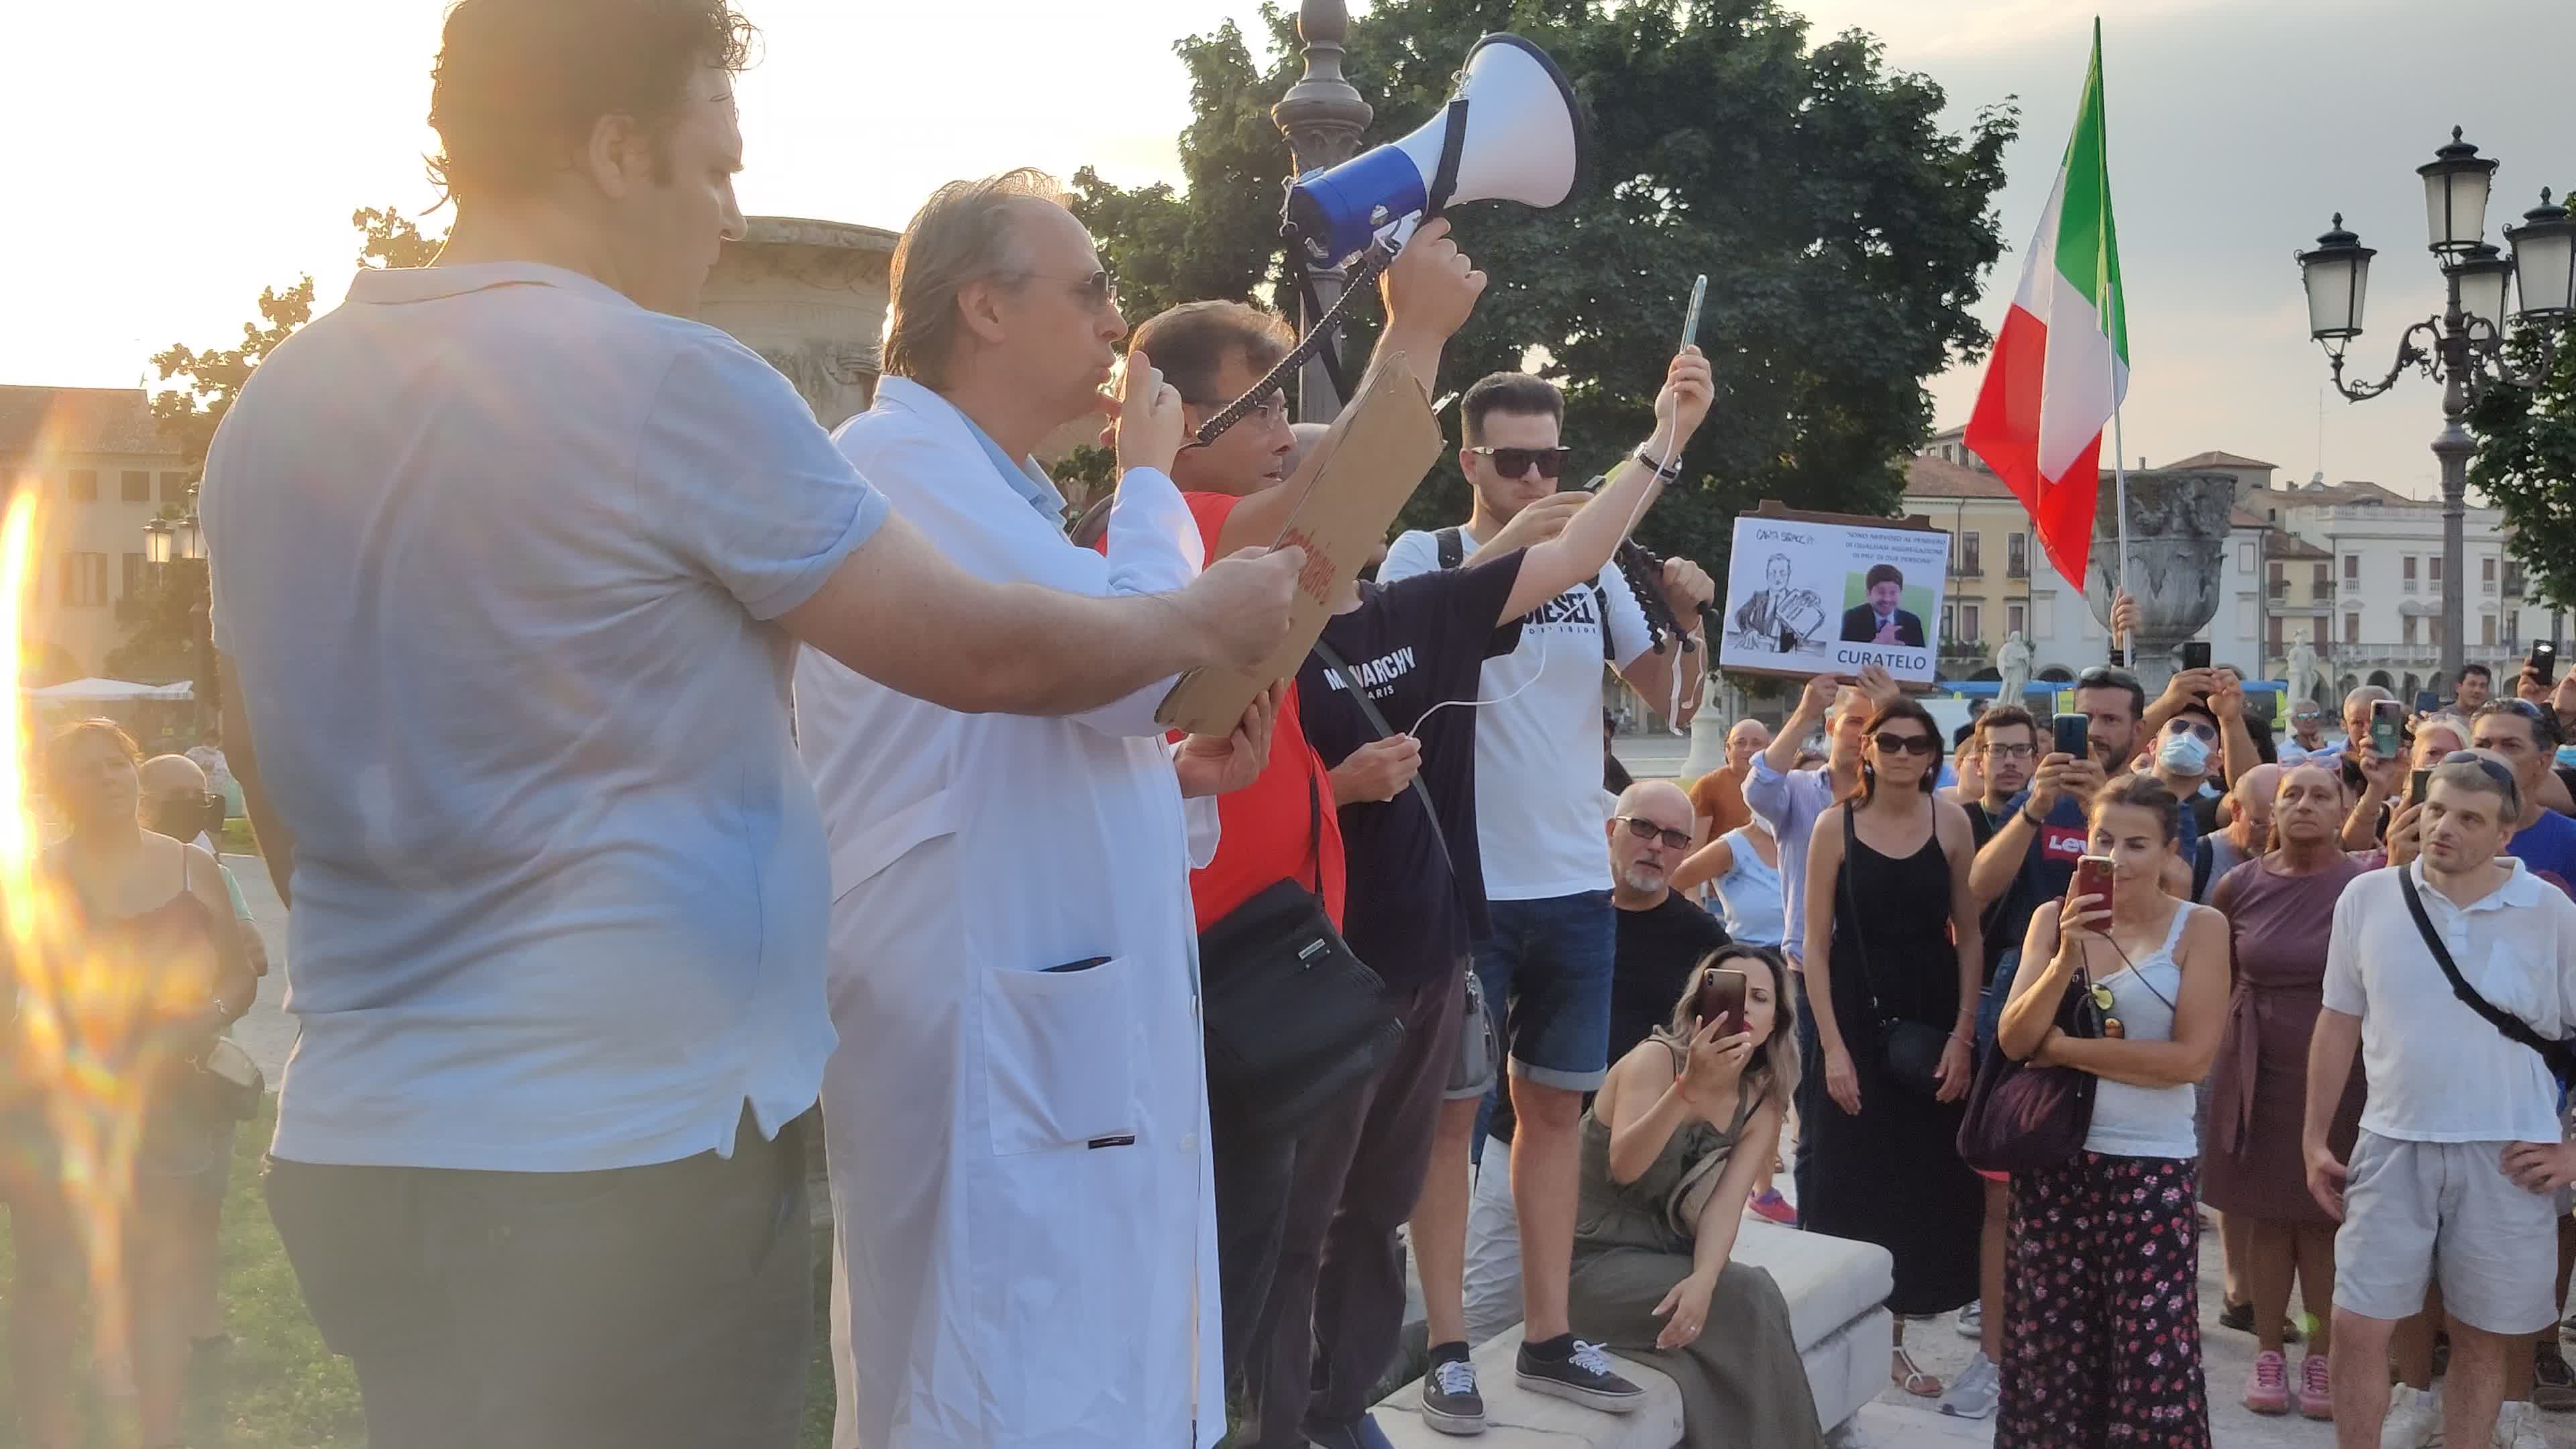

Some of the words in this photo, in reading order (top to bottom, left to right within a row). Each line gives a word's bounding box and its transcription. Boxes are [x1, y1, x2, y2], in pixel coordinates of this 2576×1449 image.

[1324, 646, 1416, 691] MNARCHY
[1838, 650, 1927, 670] CURATELO
[1367, 685, 1394, 700] ARIS
